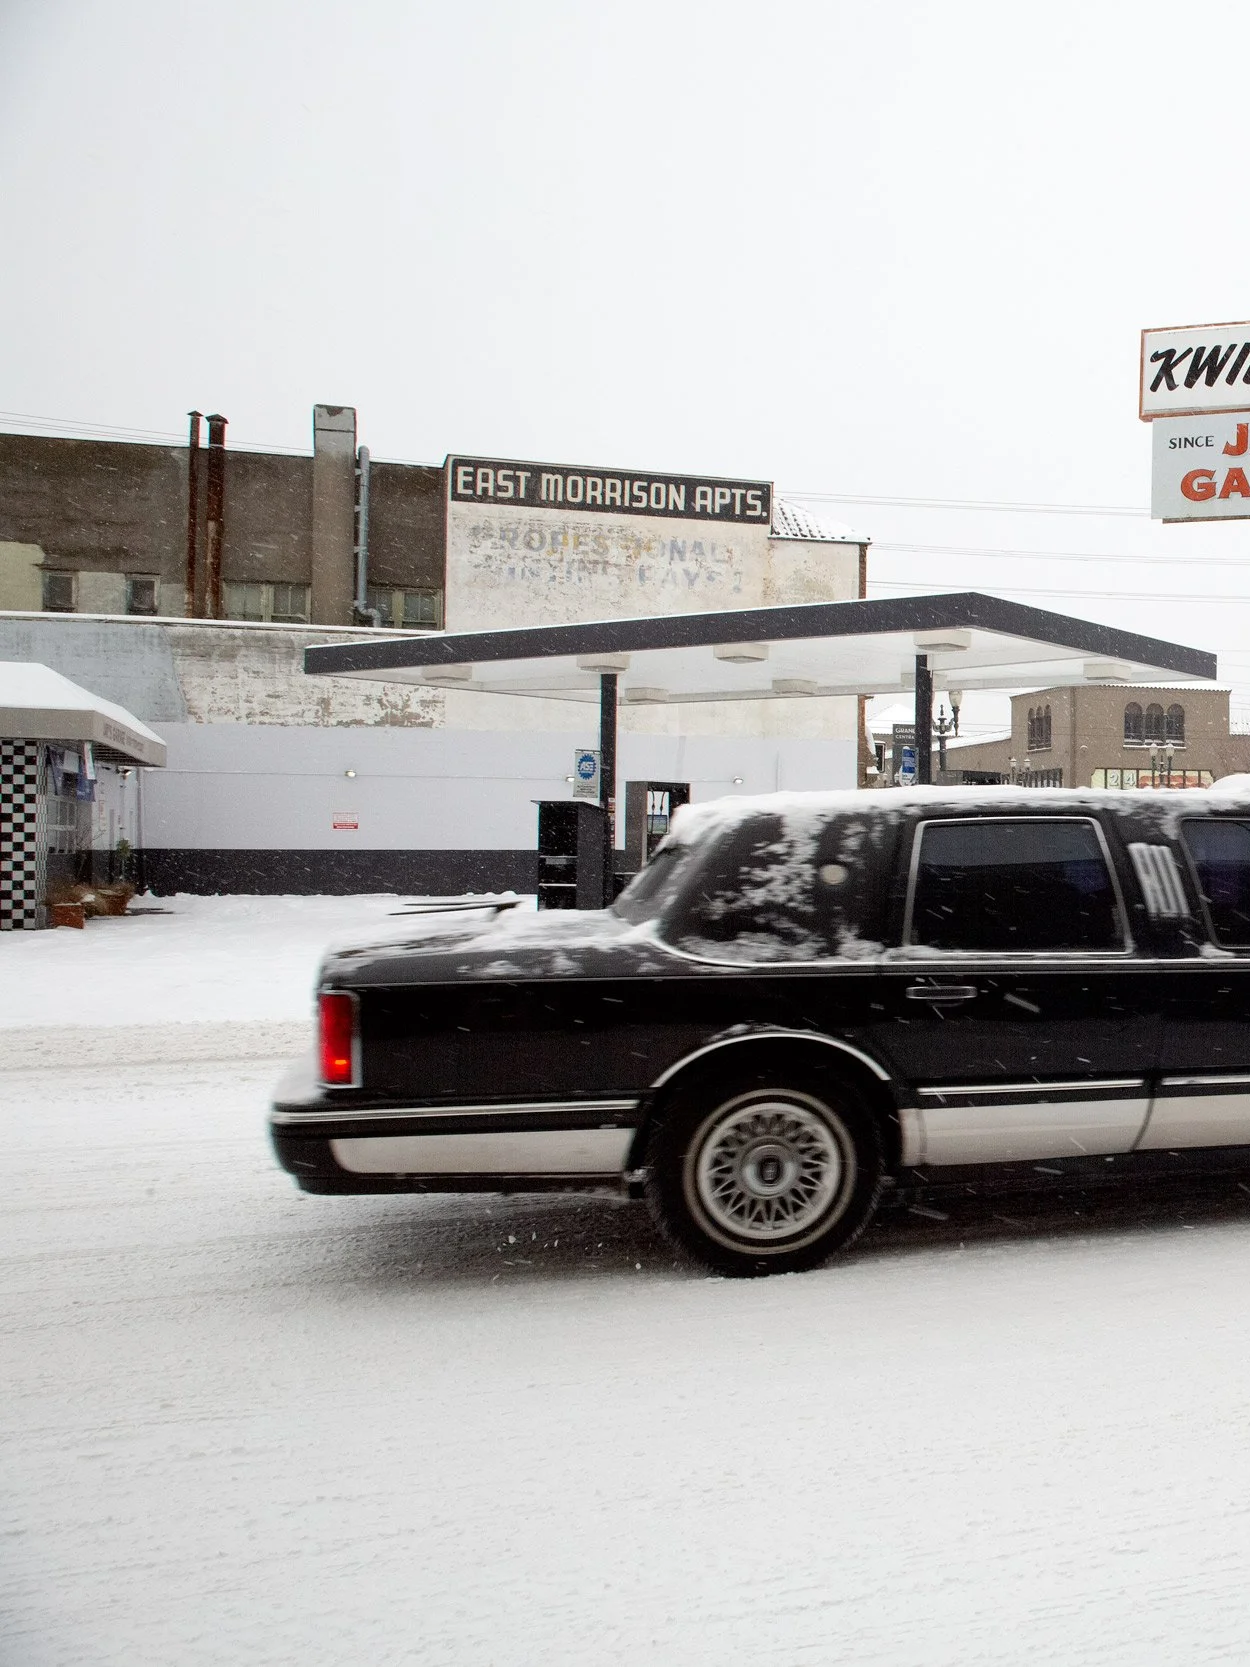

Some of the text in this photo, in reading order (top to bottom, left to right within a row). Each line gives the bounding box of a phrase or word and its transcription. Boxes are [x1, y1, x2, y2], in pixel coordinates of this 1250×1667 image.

[1168, 435, 1215, 450] SINCE
[456, 465, 768, 517] EAST MORRISON APTS.
[580, 761, 595, 770] ASE
